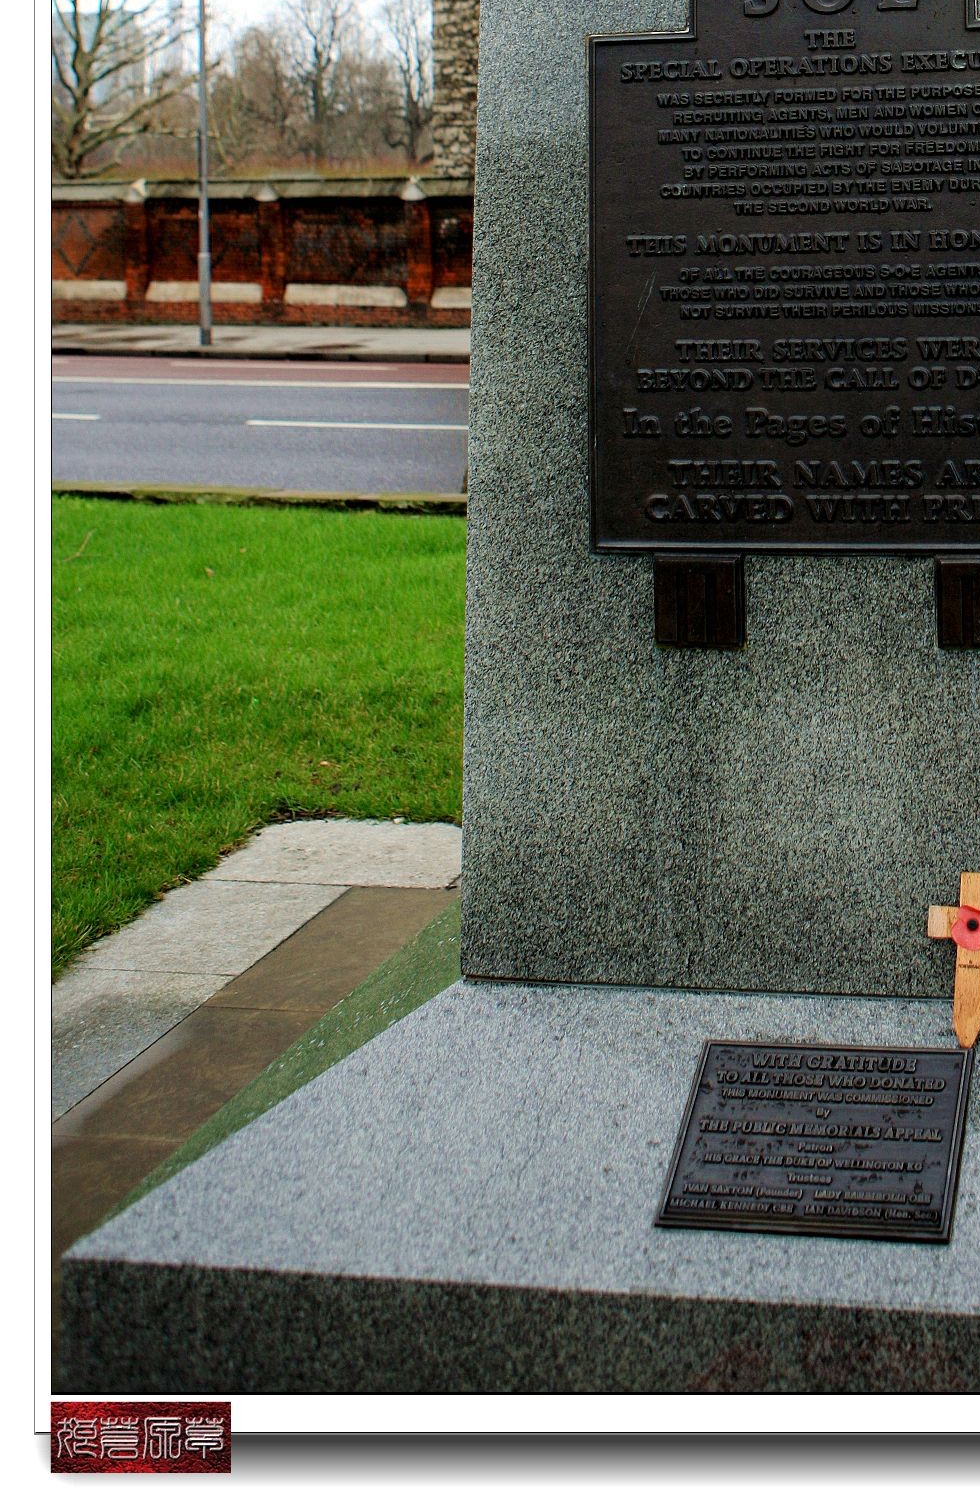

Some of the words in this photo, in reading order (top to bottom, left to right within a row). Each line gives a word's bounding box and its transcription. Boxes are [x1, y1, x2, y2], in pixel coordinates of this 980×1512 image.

[805, 29, 856, 49] THE
[620, 60, 721, 82] SPECIAL
[729, 52, 892, 79] OPERATIONS
[657, 93, 690, 107] WAS
[694, 90, 770, 106] SECRETLY
[774, 89, 837, 103] FORMED
[842, 88, 872, 100] FOR
[876, 87, 906, 99] THE
[673, 109, 763, 125] RECRUITING
[767, 108, 833, 123] AGENTS,
[836, 106, 868, 119] MEN
[873, 105, 905, 118] AND
[909, 103, 968, 117] WOMEN
[658, 129, 700, 144] MANY
[704, 126, 815, 142] NATIONALITIES
[819, 125, 855, 139] WHO
[858, 124, 914, 137] WOULD
[682, 148, 702, 160] TO
[706, 145, 783, 160] CONTINUE
[786, 144, 815, 157] THE
[820, 143, 864, 156] FIGHT
[869, 141, 900, 155] FOR
[683, 166, 704, 179] BY
[708, 164, 807, 178] PERFORMING
[812, 162, 850, 176] ACTS
[855, 161, 877, 174] OF
[881, 160, 963, 173] SABOTAGE
[660, 183, 745, 198] COUNTRIES
[751, 181, 827, 196] OCCUPIED
[831, 180, 855, 194] BY
[857, 180, 886, 193] THE
[891, 178, 944, 192] ENEMY
[734, 201, 764, 216] THE
[767, 200, 830, 214] SECOND
[834, 198, 889, 211] WORLD
[893, 197, 932, 211] WAR.
[626, 235, 687, 256] THIS
[694, 232, 850, 256] MONUMENT
[857, 232, 882, 252] IS
[890, 230, 921, 251] IN
[679, 267, 700, 282] OF
[703, 267, 733, 282] ALL
[735, 266, 766, 281] THE
[769, 265, 875, 281] COURAGEOUS
[659, 286, 711, 301] THOSE
[713, 286, 749, 300] WHO
[753, 285, 780, 300] DID
[783, 284, 850, 299] SURVIVE
[854, 284, 886, 299] AND
[890, 283, 942, 298] THOSE
[680, 305, 711, 319] NOT
[715, 304, 779, 319] SURVIVE
[782, 303, 828, 318] THEIR
[832, 302, 908, 316] PERILOUS
[675, 339, 764, 363] THEIR
[773, 338, 907, 362] SERVICES
[636, 369, 754, 392] BEYOND
[760, 367, 817, 391] THE
[825, 366, 899, 390] CALL
[908, 366, 949, 389] OF
[623, 408, 661, 439] In
[674, 408, 732, 438] the
[745, 407, 846, 445] Pages
[860, 405, 900, 438] of
[668, 459, 781, 489] THEIR
[793, 459, 925, 488] NAMES
[645, 494, 792, 523] CARVED
[806, 494, 910, 523] WITH
[752, 1053, 802, 1068] WITH
[807, 1055, 916, 1073] GRATITUDE
[717, 1071, 739, 1083] TO
[741, 1071, 770, 1083] ALL
[773, 1073, 824, 1087] THOSE
[829, 1075, 866, 1088] WHO
[869, 1076, 946, 1092] DONATED
[722, 1088, 746, 1099] THIS
[748, 1089, 816, 1101] MONUMENT
[817, 1091, 843, 1102] WAS
[845, 1092, 934, 1105] COMMISSIONED
[700, 1119, 729, 1132] THE
[731, 1121, 787, 1134] PUBLIC
[789, 1123, 880, 1140] MEMORIALS
[883, 1128, 942, 1141] APPEAL
[817, 1158, 833, 1168] OF
[834, 1160, 903, 1172] WELLINGTON
